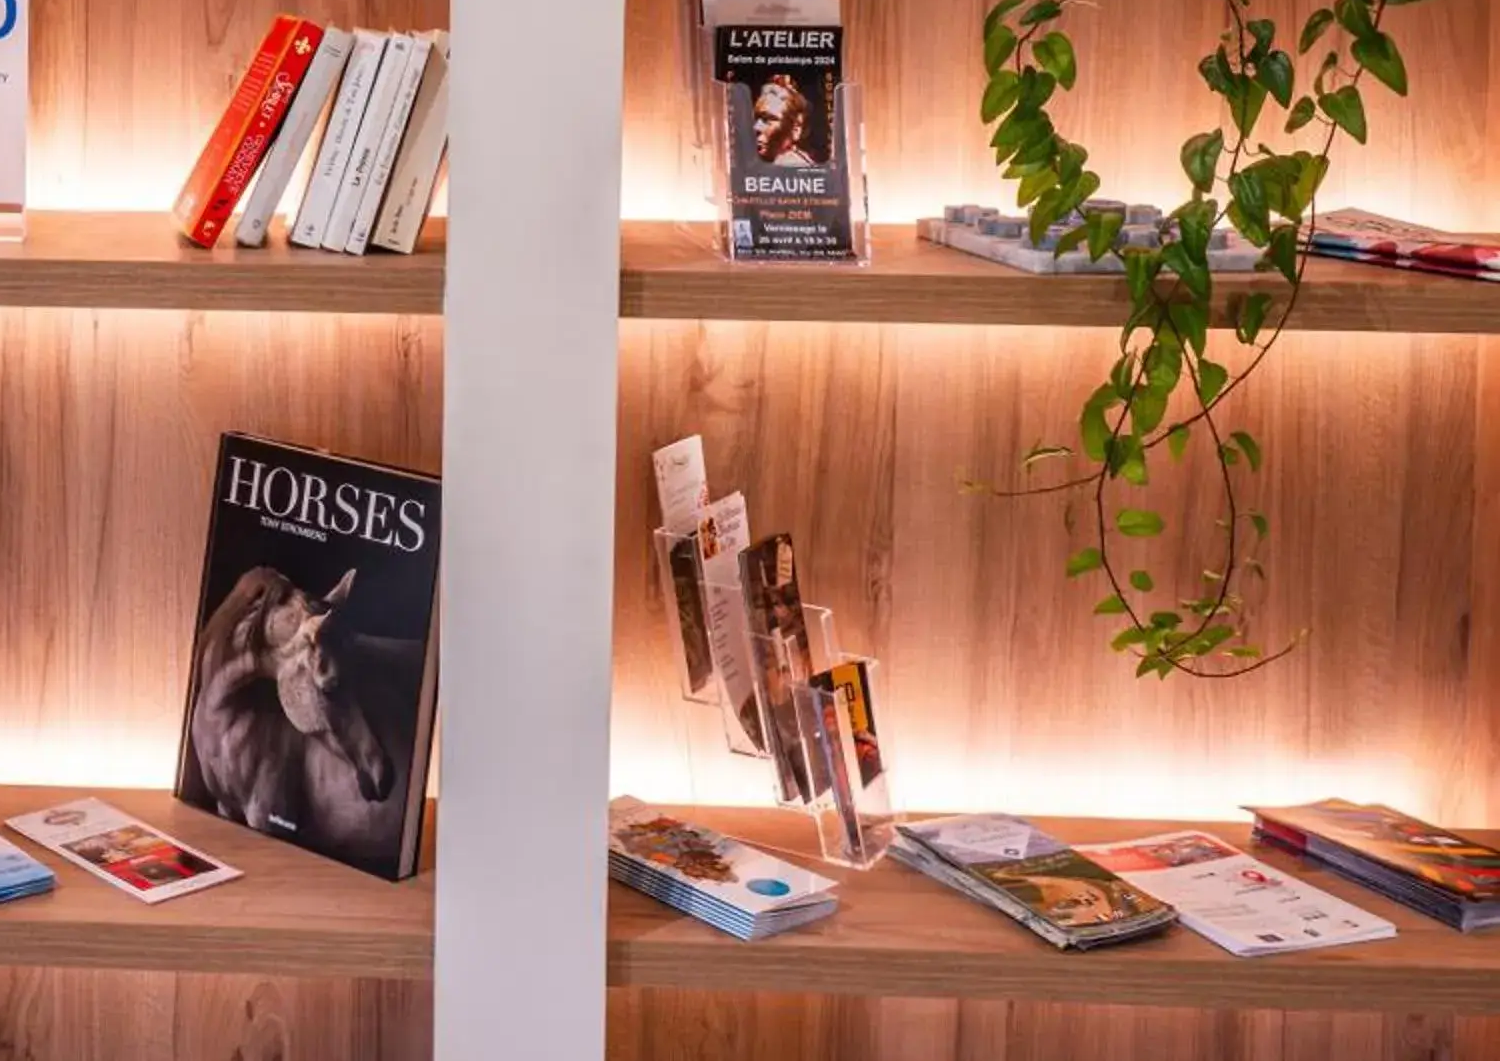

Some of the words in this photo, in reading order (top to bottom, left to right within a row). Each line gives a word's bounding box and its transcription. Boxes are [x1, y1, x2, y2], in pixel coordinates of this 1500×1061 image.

[730, 30, 835, 48] L'ATELIER
[727, 54, 752, 64] Salon
[755, 54, 766, 64] de
[745, 177, 825, 194] BEAUNE
[223, 455, 426, 552] HORSES
